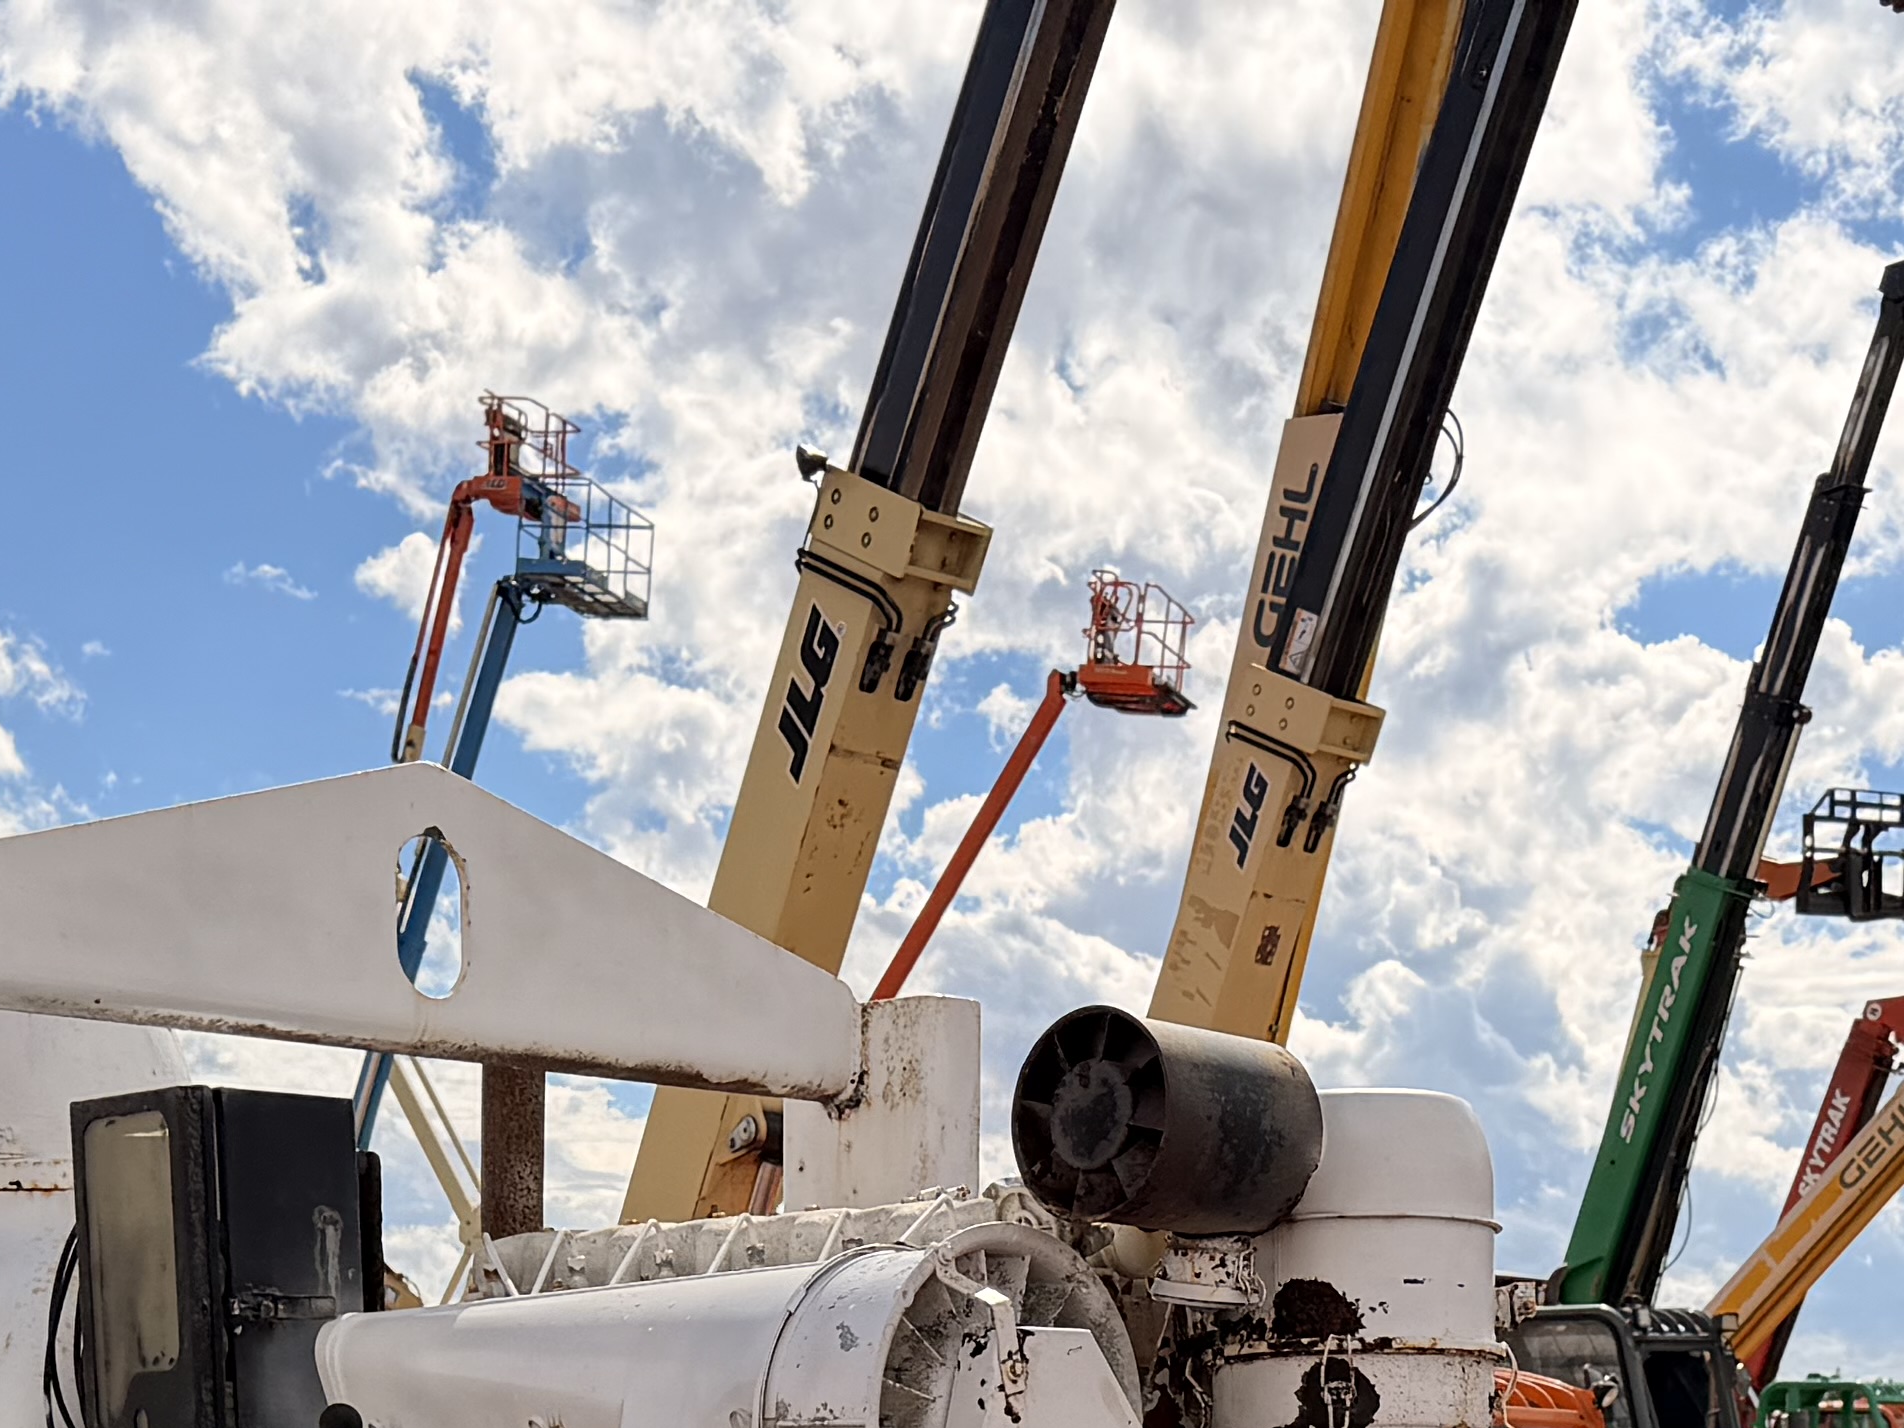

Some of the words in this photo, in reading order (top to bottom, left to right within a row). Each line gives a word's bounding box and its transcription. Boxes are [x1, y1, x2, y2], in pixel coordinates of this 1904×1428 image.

[1253, 462, 1319, 648] GEHL
[778, 603, 839, 784] JLG
[1228, 762, 1269, 869] JLG
[1620, 915, 1697, 1144] SKYTRAK
[1798, 1088, 1851, 1197] SKYTRAK
